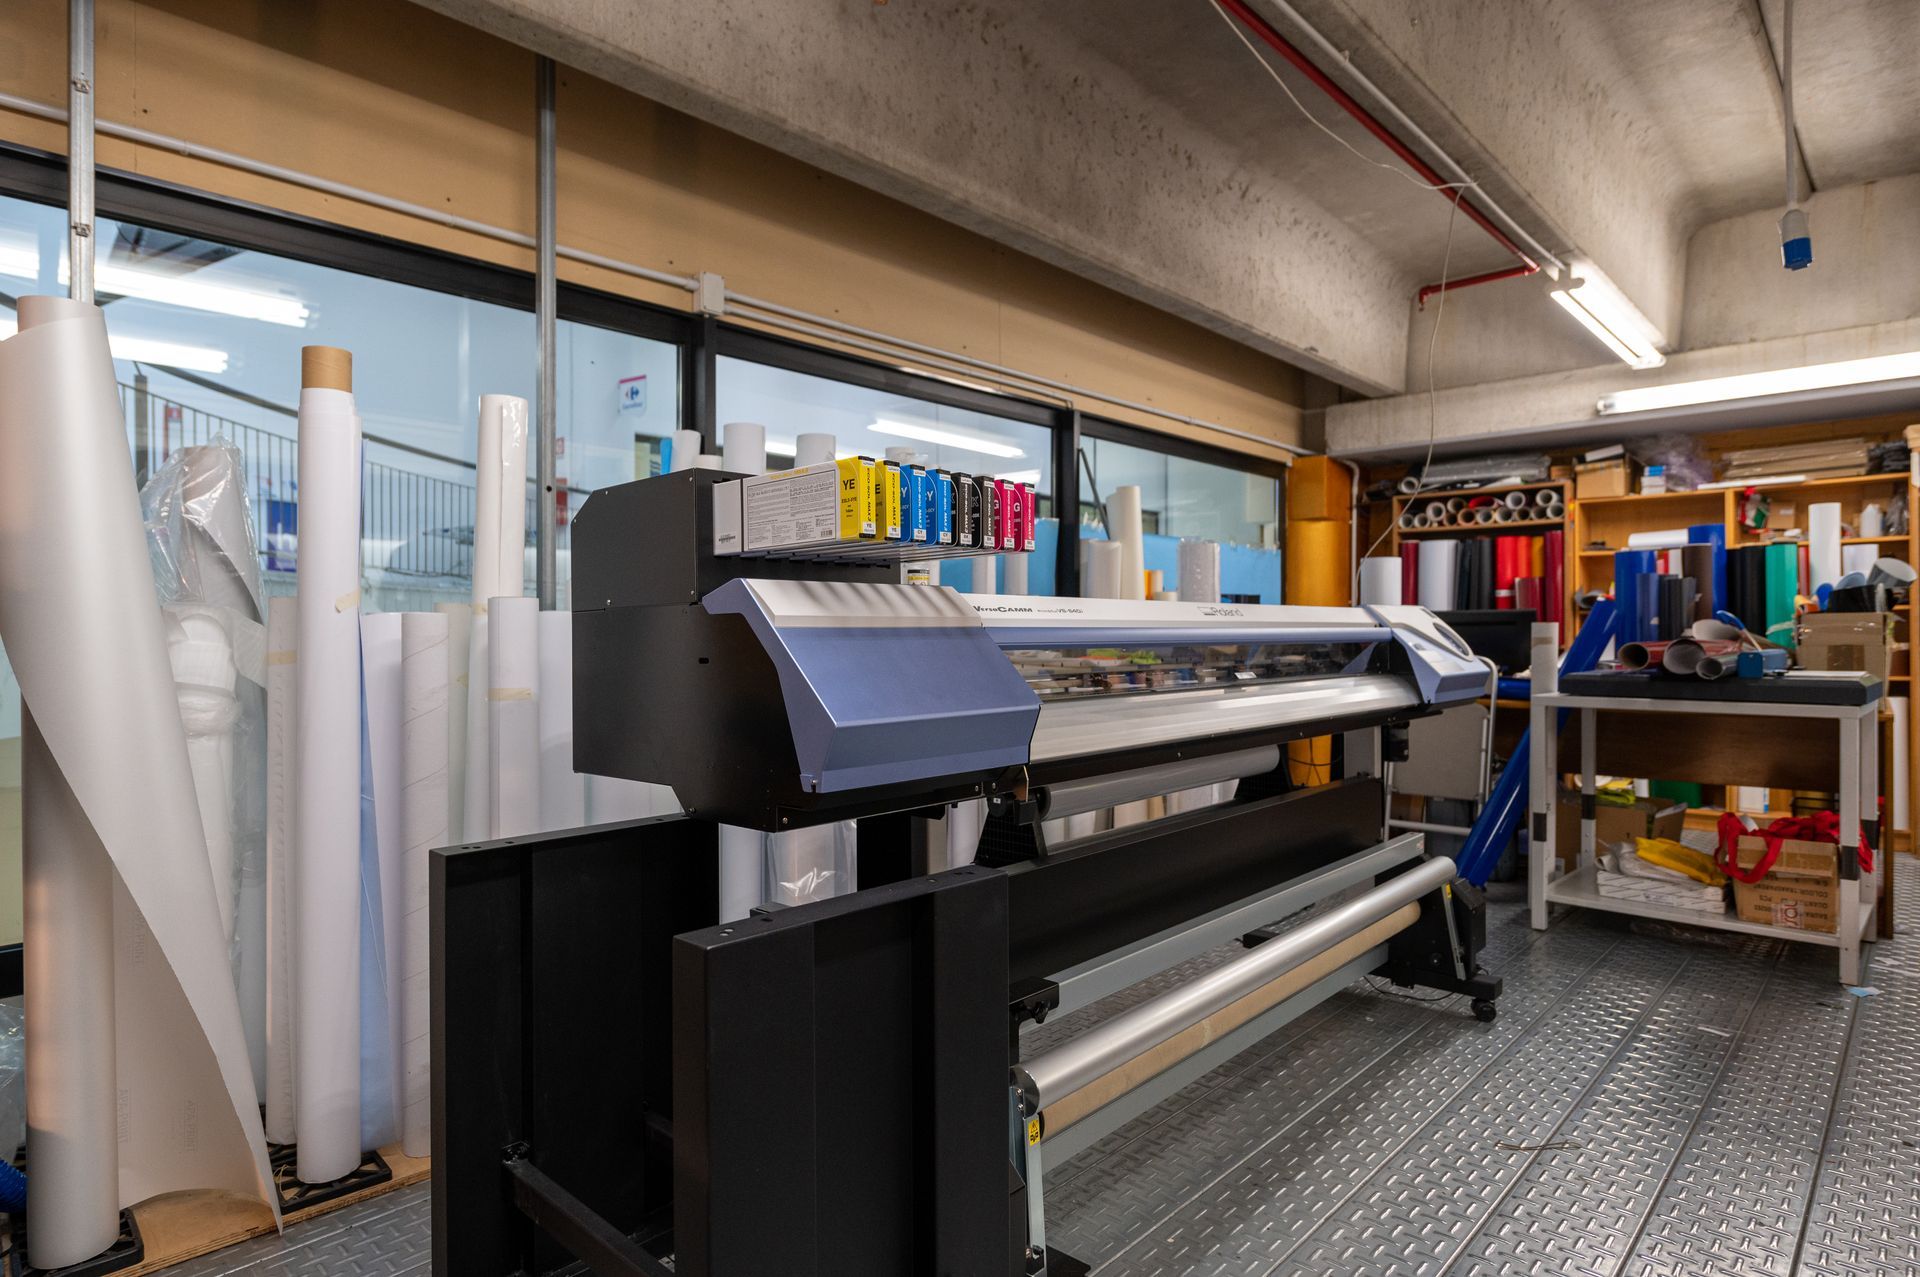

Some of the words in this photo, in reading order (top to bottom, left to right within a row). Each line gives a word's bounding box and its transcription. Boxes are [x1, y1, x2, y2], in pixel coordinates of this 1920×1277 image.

[843, 479, 855, 490] YE
[875, 484, 881, 494] E
[901, 487, 907, 498] Y
[926, 491, 933, 501] Y
[971, 496, 979, 507] K
[1014, 503, 1020, 512] G
